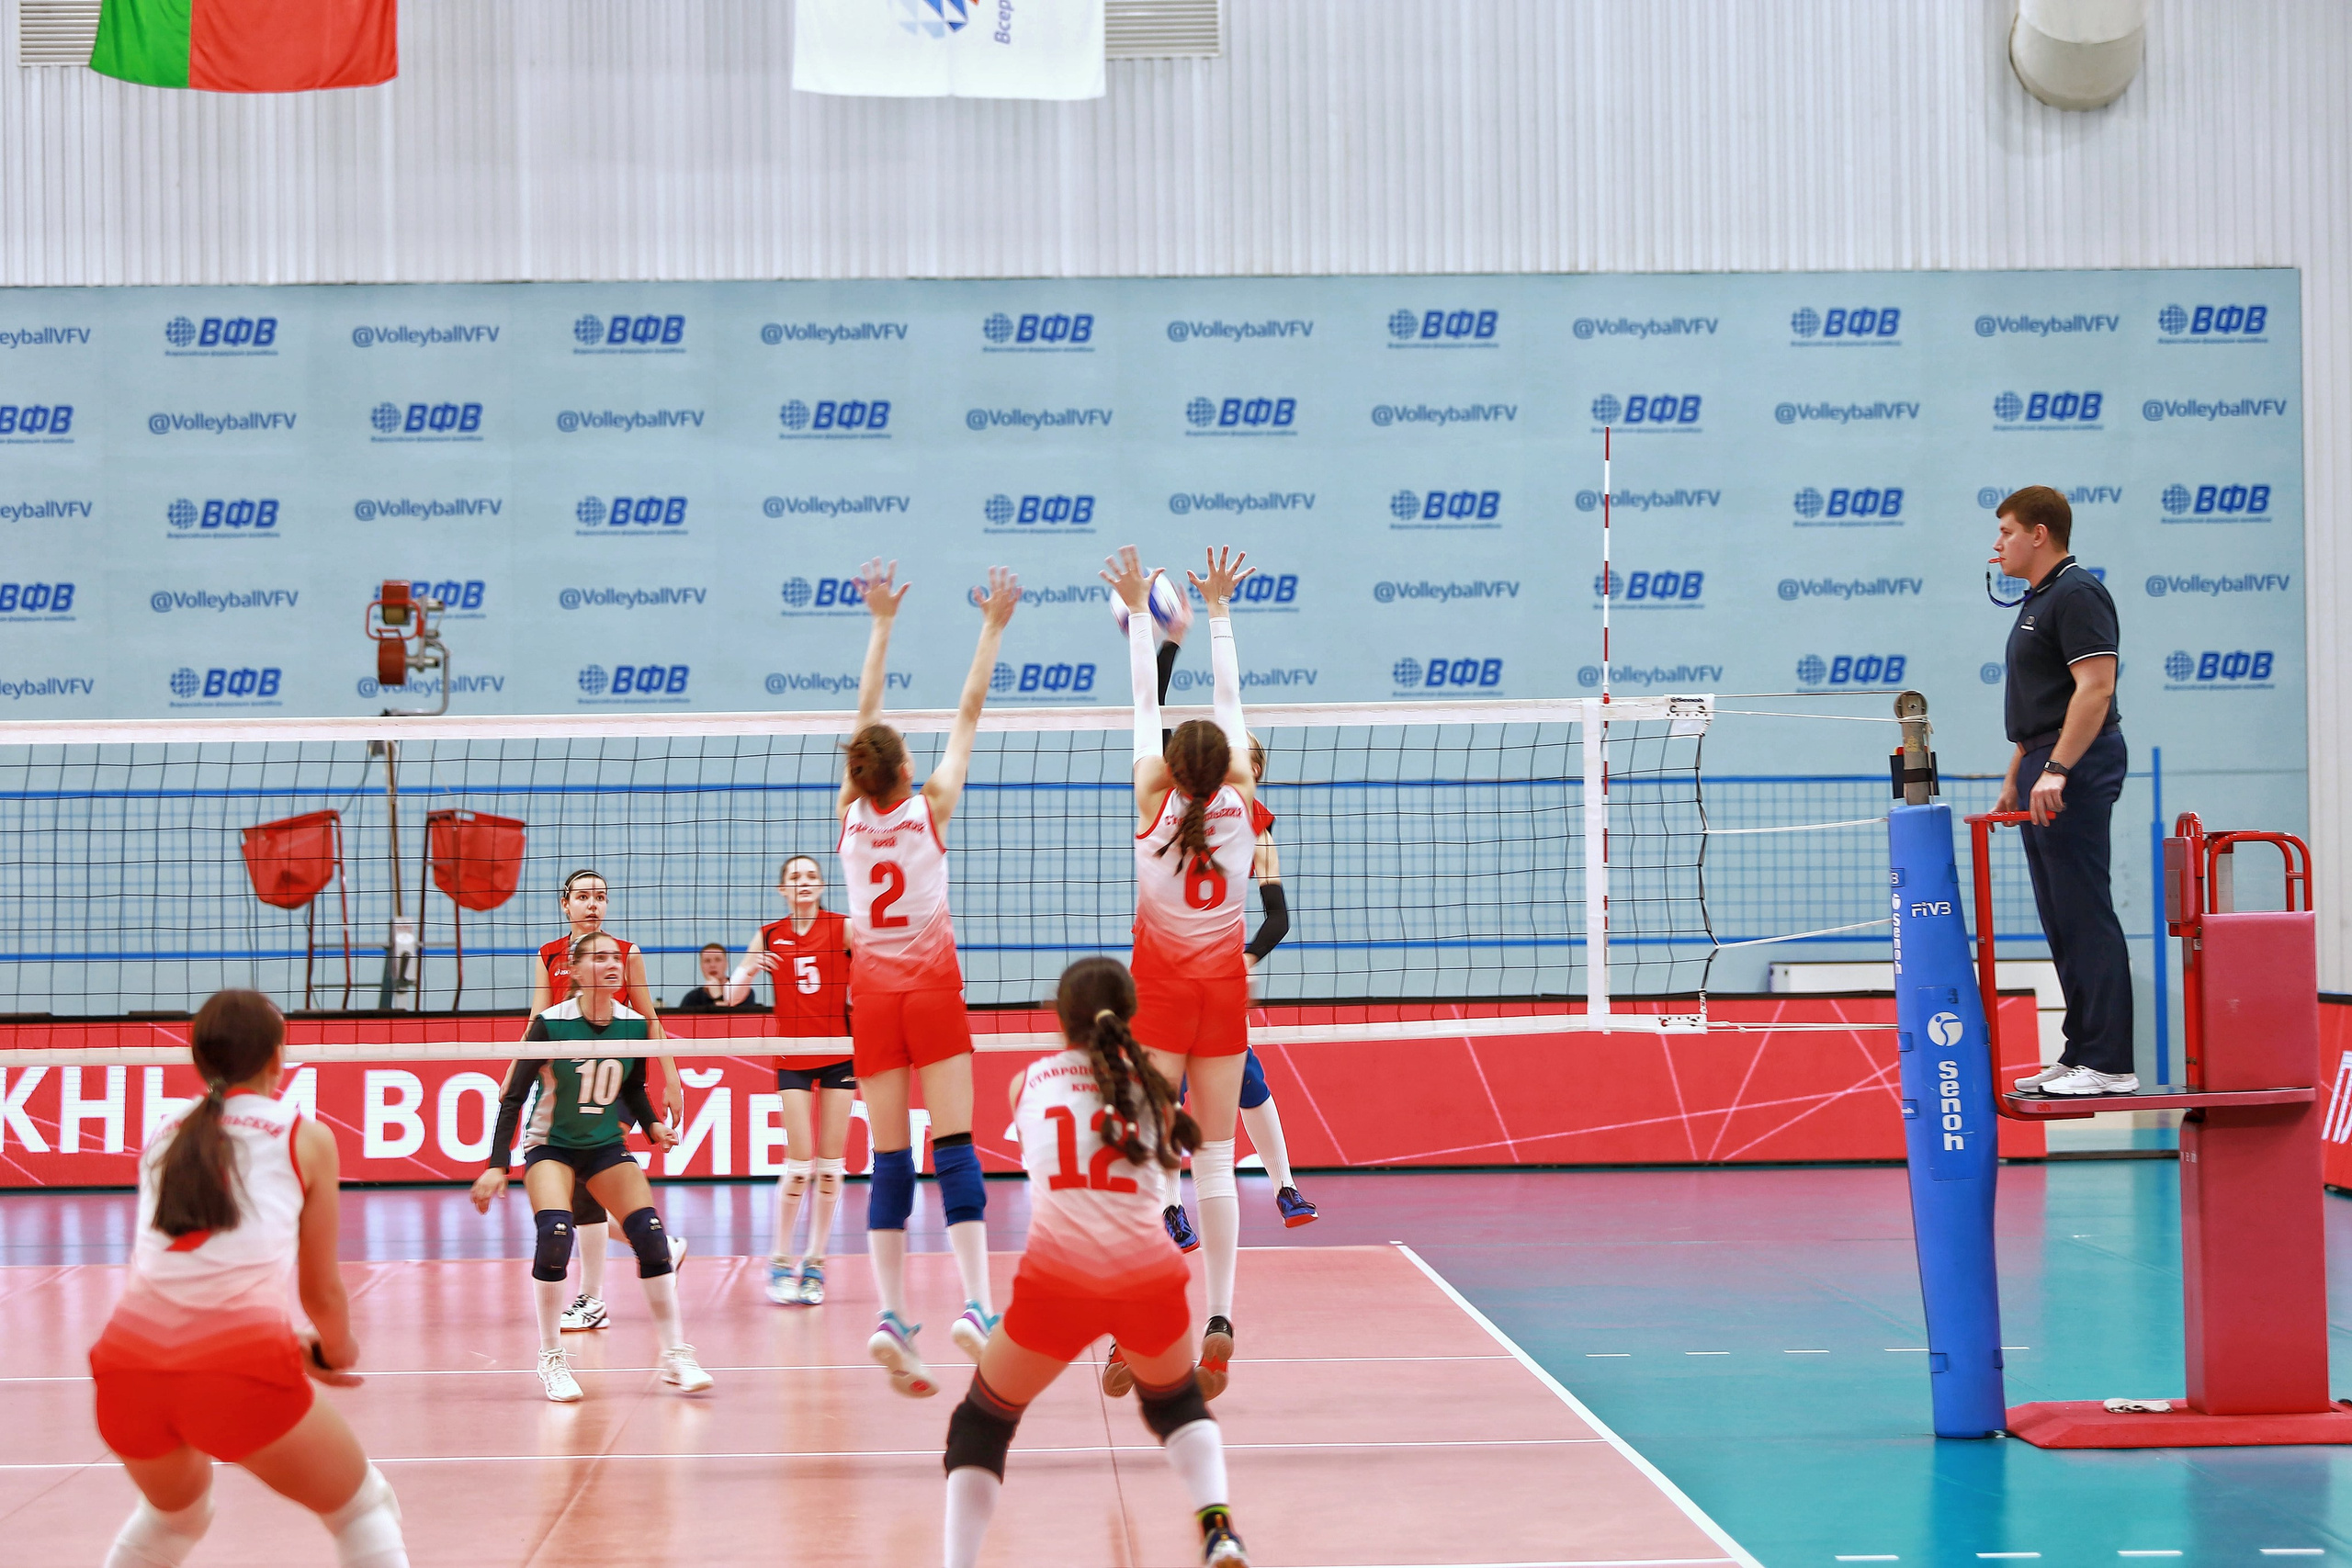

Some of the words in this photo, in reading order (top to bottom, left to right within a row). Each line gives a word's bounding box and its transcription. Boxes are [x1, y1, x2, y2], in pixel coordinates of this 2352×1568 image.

[198, 316, 278, 347] ВФВ
[606, 314, 685, 345] ВФВ
[760, 322, 908, 345] @VolleyballVFV
[1016, 313, 1094, 344] ВФВ
[1167, 320, 1314, 343] @VolleyballVFV
[1420, 309, 1499, 340] ВФВ
[1572, 317, 1718, 339] @VolleyballVFV
[1824, 307, 1902, 338] ВФВ
[1974, 314, 2120, 337] @VolleyballVFV
[2190, 304, 2268, 335] ВФВ
[352, 325, 500, 348] @VolleyballVFV
[403, 401, 483, 434] ВФВ
[556, 409, 705, 433] @VolleyballVFV
[812, 399, 892, 430] ВФВ
[966, 408, 1113, 431] @VolleyballVFV
[1218, 397, 1297, 428] ВФВ
[1371, 404, 1518, 426] @VolleyballVFV
[1623, 393, 1702, 424] ВФВ
[1774, 401, 1920, 424] @VolleyballVFV
[2026, 390, 2104, 422] ВФВ
[2143, 399, 2287, 422] @VolleyballVFV
[148, 412, 297, 434] @VolleyballVFV
[199, 498, 280, 530] ВФВ
[354, 498, 502, 522] @VolleyballVFV
[608, 495, 688, 527] ВФВ
[763, 495, 910, 518] @VolleyballVFV
[1016, 493, 1096, 525] ВФВ
[1169, 492, 1316, 514] @VolleyballVFV
[1422, 490, 1501, 521] ВФВ
[1826, 487, 1905, 518] ВФВ
[2194, 483, 2272, 514] ВФВ
[559, 587, 707, 610] @VolleyballVFV
[1373, 581, 1520, 604] @VolleyballVFV
[1625, 570, 1705, 601] ВФВ
[1777, 577, 1923, 601] @VolleyballVFV
[2145, 573, 2290, 597] @VolleyballVFV
[150, 589, 299, 613] @VolleyballVFV
[611, 664, 690, 695] ВФВ
[1018, 662, 1096, 693] ВФВ
[1425, 657, 1504, 688] ВФВ
[1828, 653, 1907, 684] ВФВ
[2197, 649, 2275, 681] ВФВ
[202, 667, 282, 698] ВФВ
[1185, 845, 1227, 911] 6
[871, 861, 909, 928] 2
[794, 955, 821, 994] 5
[574, 1059, 624, 1106] 10
[1045, 1105, 1139, 1193] 12
